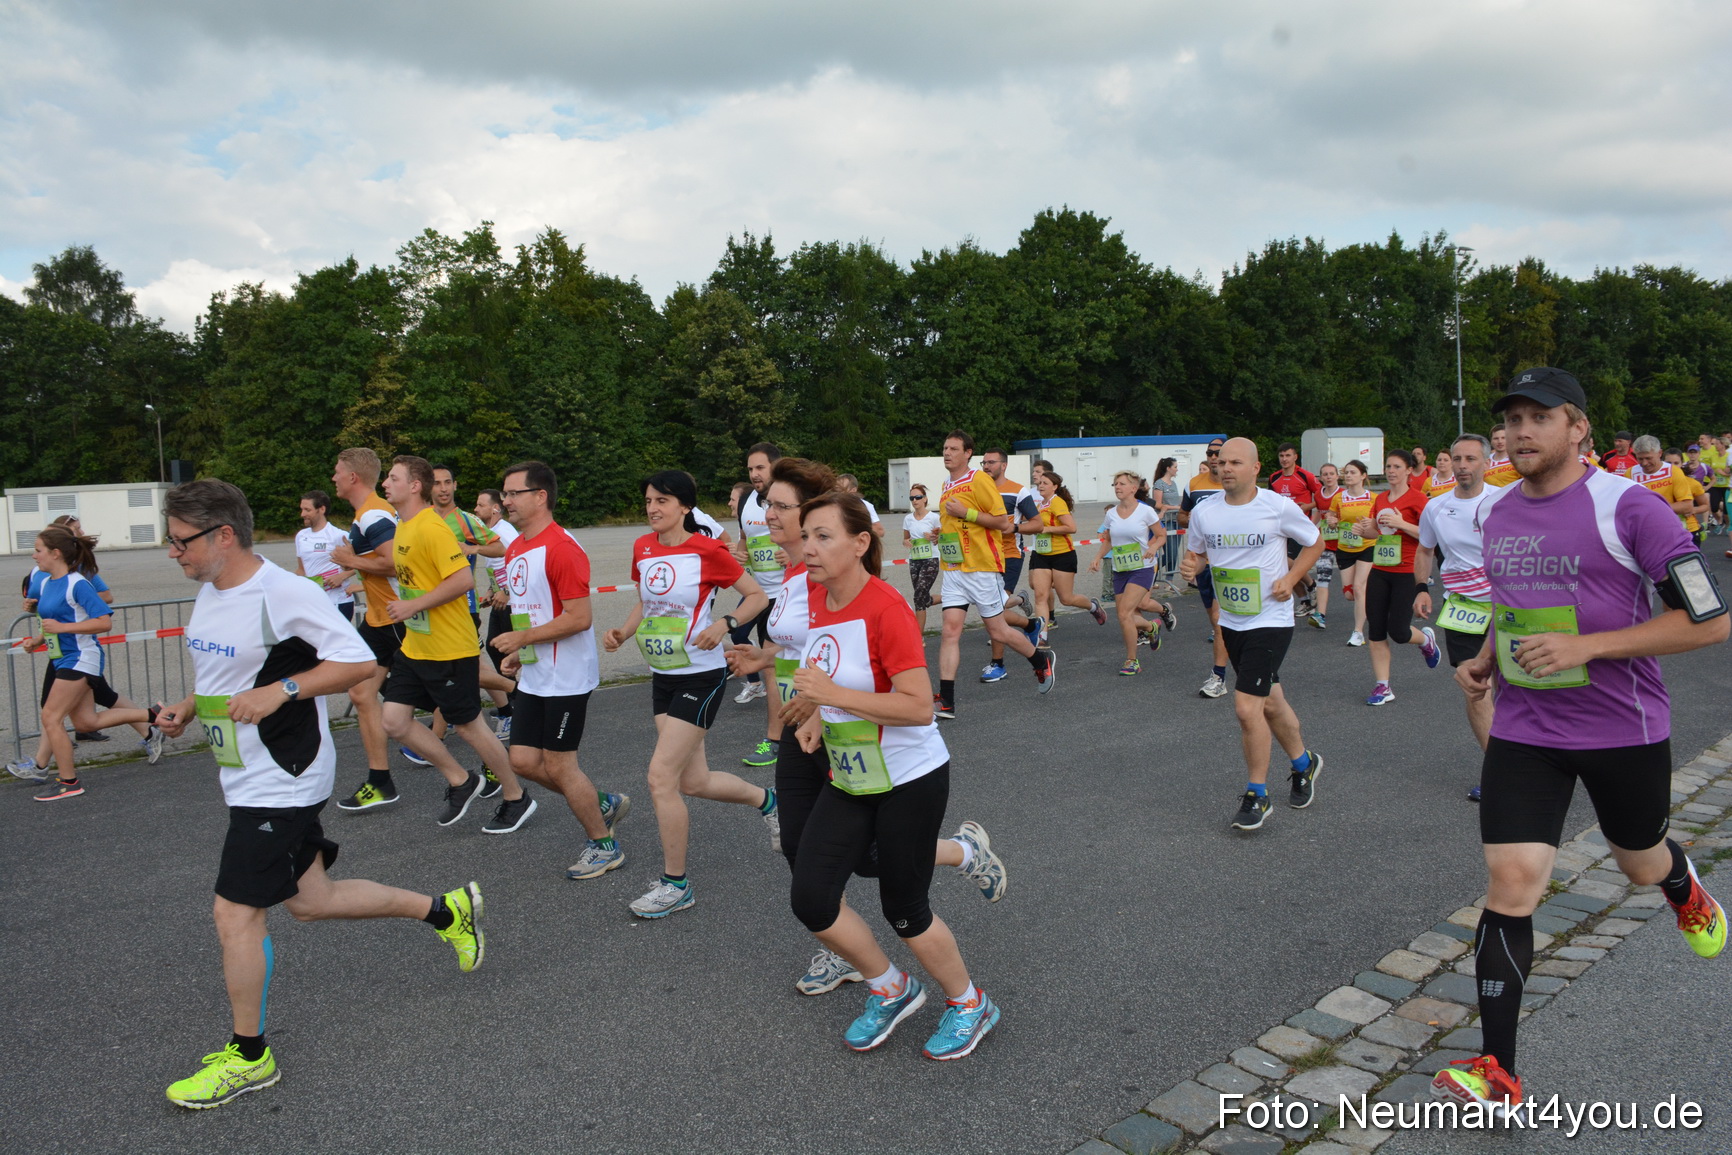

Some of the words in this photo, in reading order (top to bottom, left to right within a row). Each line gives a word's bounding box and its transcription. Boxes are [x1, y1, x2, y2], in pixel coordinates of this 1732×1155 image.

[951, 485, 973, 497] BÖGL
[912, 545, 930, 555] 1115
[941, 544, 957, 555] 853
[1378, 547, 1395, 557] 496
[1487, 535, 1547, 556] HECK
[753, 549, 774, 563] 582
[1116, 551, 1140, 565] 1116
[1491, 555, 1580, 577] DESIGN
[1532, 581, 1579, 592] Werbung!
[1222, 586, 1250, 602] 488
[1447, 606, 1488, 626] 1004
[645, 638, 674, 656] 538
[831, 749, 867, 775] 541
[1481, 990, 1502, 998] cep
